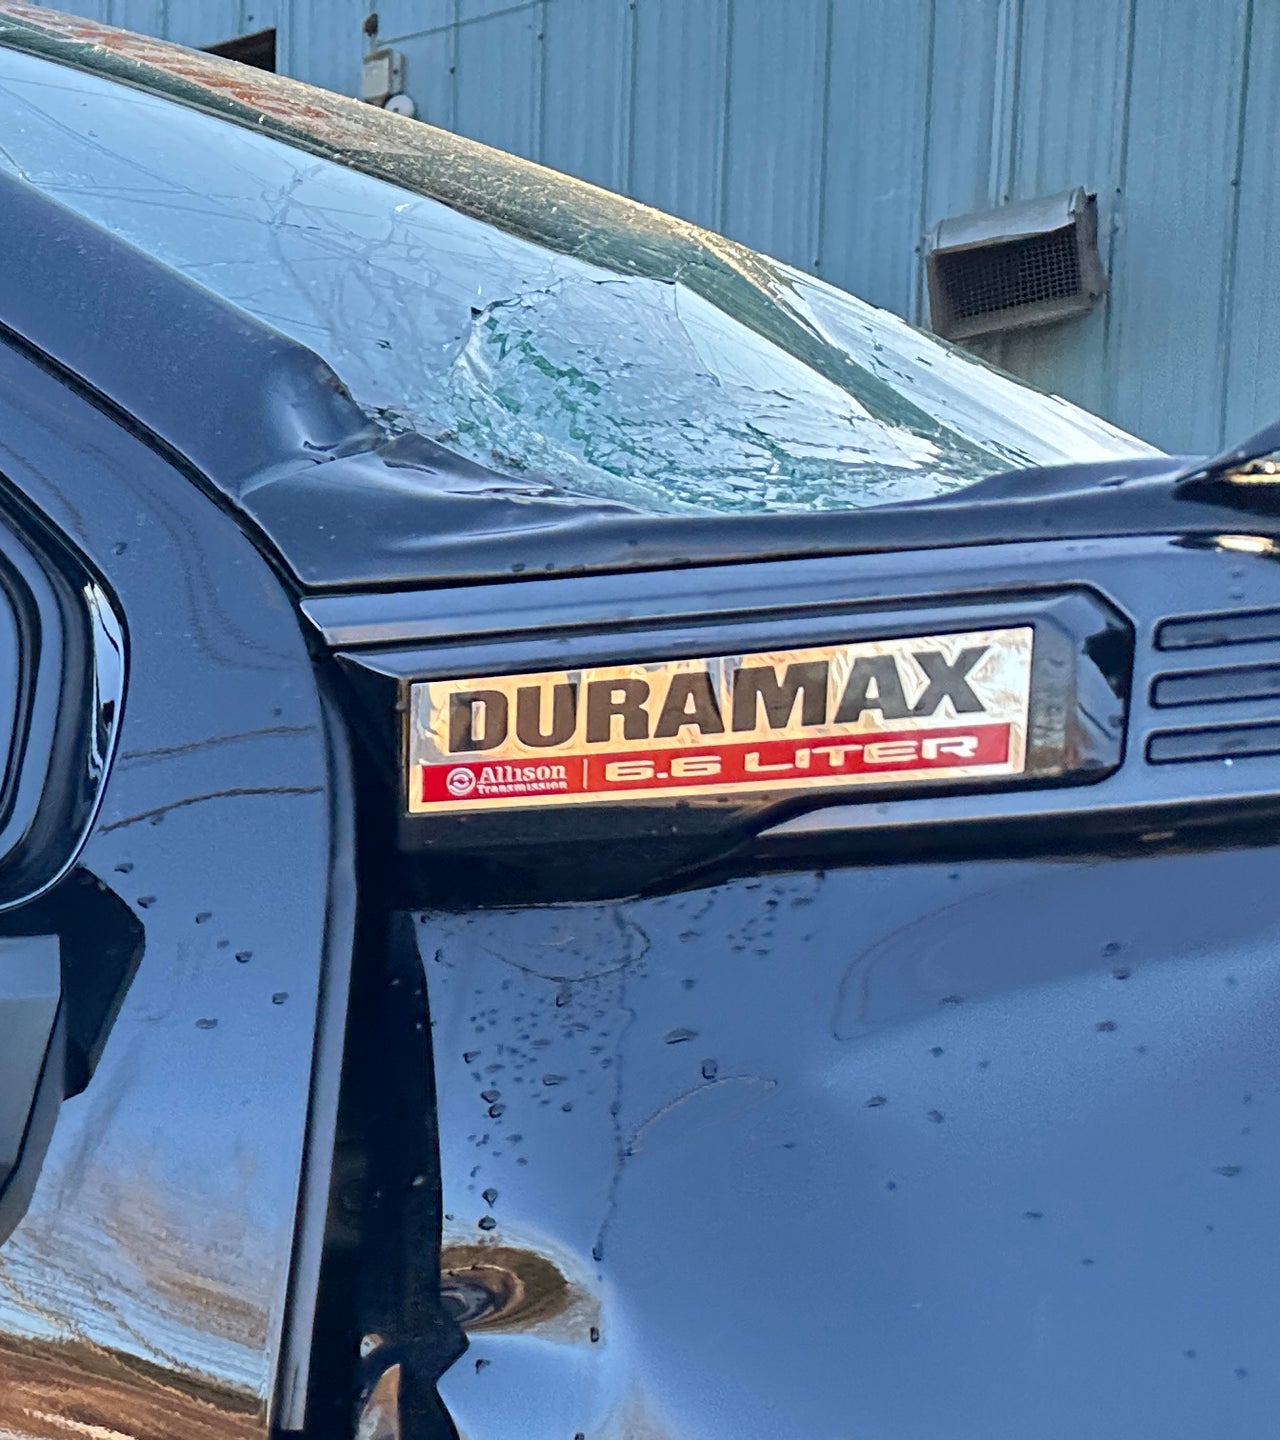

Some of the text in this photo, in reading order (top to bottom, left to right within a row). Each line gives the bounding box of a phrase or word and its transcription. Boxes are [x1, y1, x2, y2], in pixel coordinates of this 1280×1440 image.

[448, 646, 991, 753] DURAMAX
[479, 764, 568, 784] Allison
[604, 734, 980, 782] 6.6 LITER
[476, 780, 568, 795] Transmission
